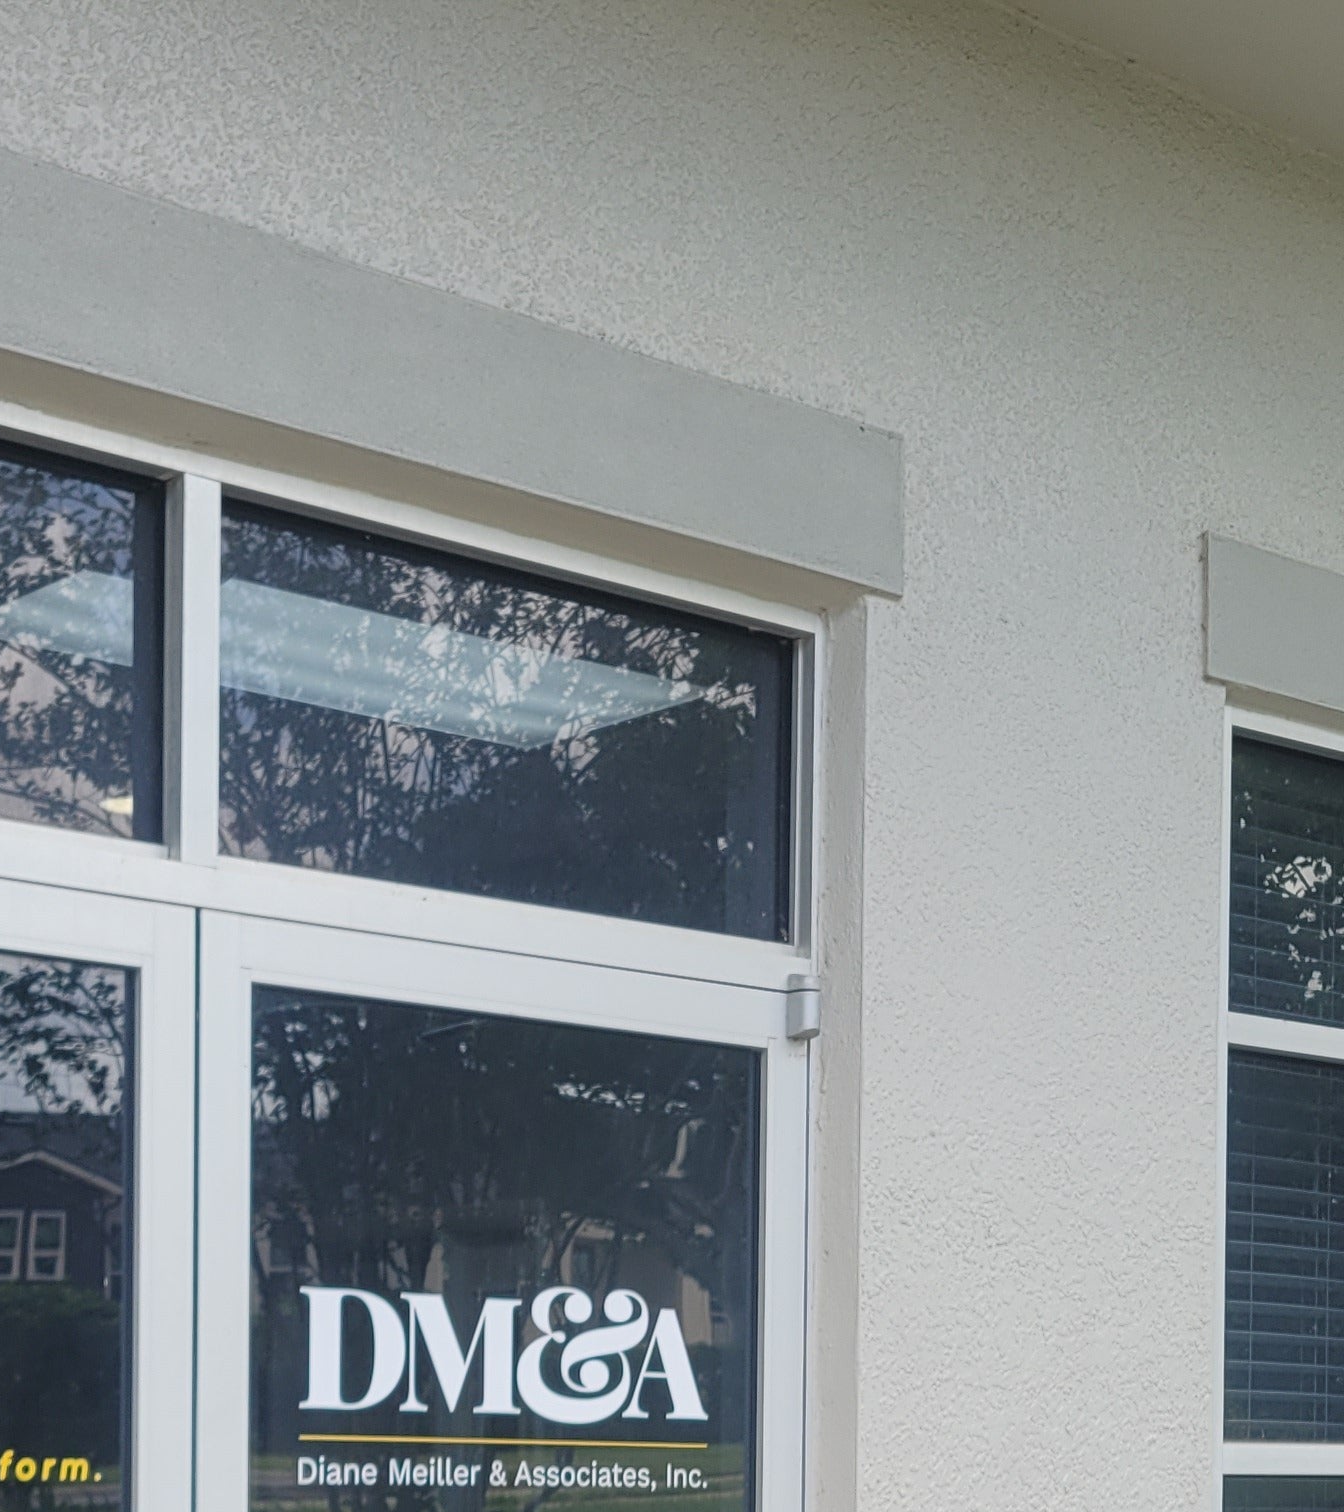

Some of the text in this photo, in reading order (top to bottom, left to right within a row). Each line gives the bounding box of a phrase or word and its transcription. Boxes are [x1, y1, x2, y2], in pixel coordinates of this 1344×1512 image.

[298, 1286, 709, 1424] DM&A
[297, 1456, 708, 1491] Diane Meiller & Associates, Inc.
